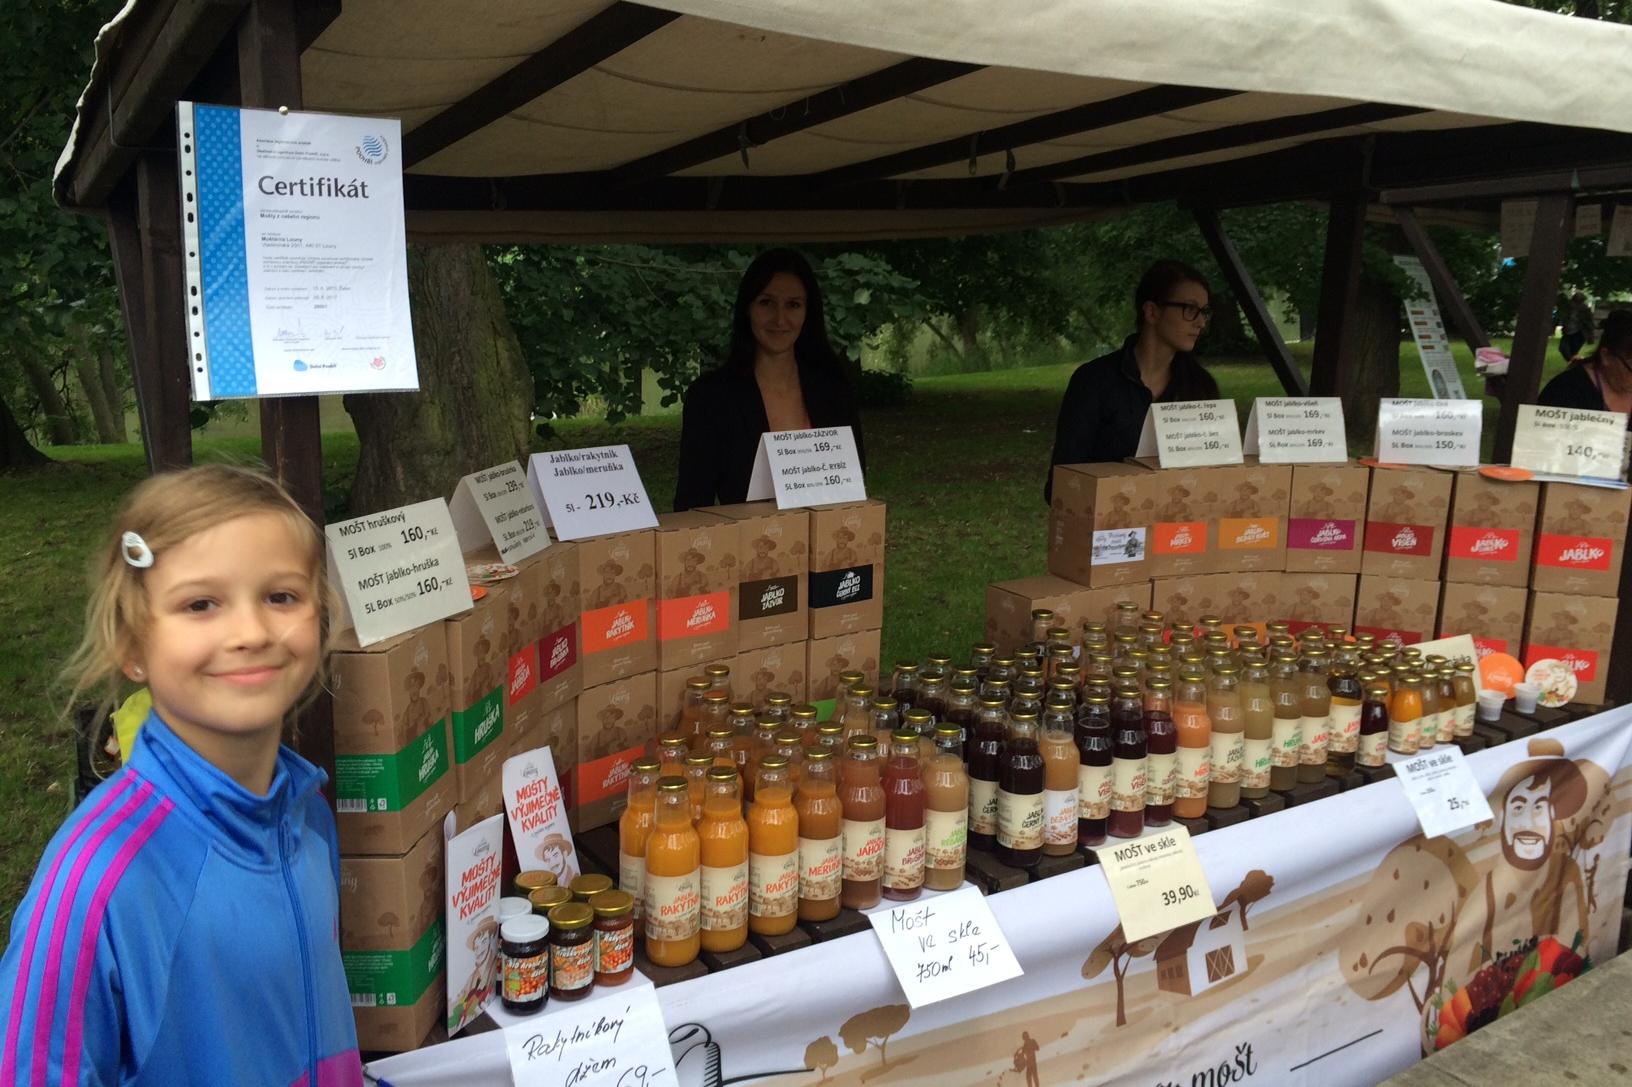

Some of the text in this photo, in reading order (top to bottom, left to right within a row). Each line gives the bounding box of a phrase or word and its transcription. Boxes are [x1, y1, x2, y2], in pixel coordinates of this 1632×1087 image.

[258, 175, 369, 199] Certifikát
[1536, 409, 1615, 425] MOŠT jablečný
[774, 433, 792, 442] MOŠT
[550, 450, 619, 464] Jablko/rakytník
[554, 462, 624, 477] Jablko/meruňka
[782, 466, 801, 476] MOŠT
[339, 511, 406, 537] MOŠT hruškový
[360, 546, 376, 558] Box
[358, 558, 440, 591] MOŠT jablko-hruška
[838, 576, 861, 590] JABLKO
[365, 602, 376, 614] 5L
[376, 598, 393, 611] Box
[760, 588, 785, 603] JABLKO
[474, 704, 500, 744] HRUŠKA
[1406, 759, 1428, 773] MOŠT
[516, 776, 548, 803] MOŠTY
[511, 786, 561, 821] VÝJIMEČNÉ
[522, 804, 558, 833] KVALITY
[1114, 844, 1144, 862] MOŠT
[1144, 844, 1157, 854] ve
[1158, 837, 1177, 850] skle
[462, 852, 497, 887] MOŠTY
[452, 862, 501, 909] VÝJIMEČNÉ
[460, 883, 497, 921] KVALITY
[892, 906, 936, 934] Mošt
[916, 956, 953, 983] 750ml
[565, 1058, 616, 1087] džem
[1192, 1042, 1258, 1087] mošt
